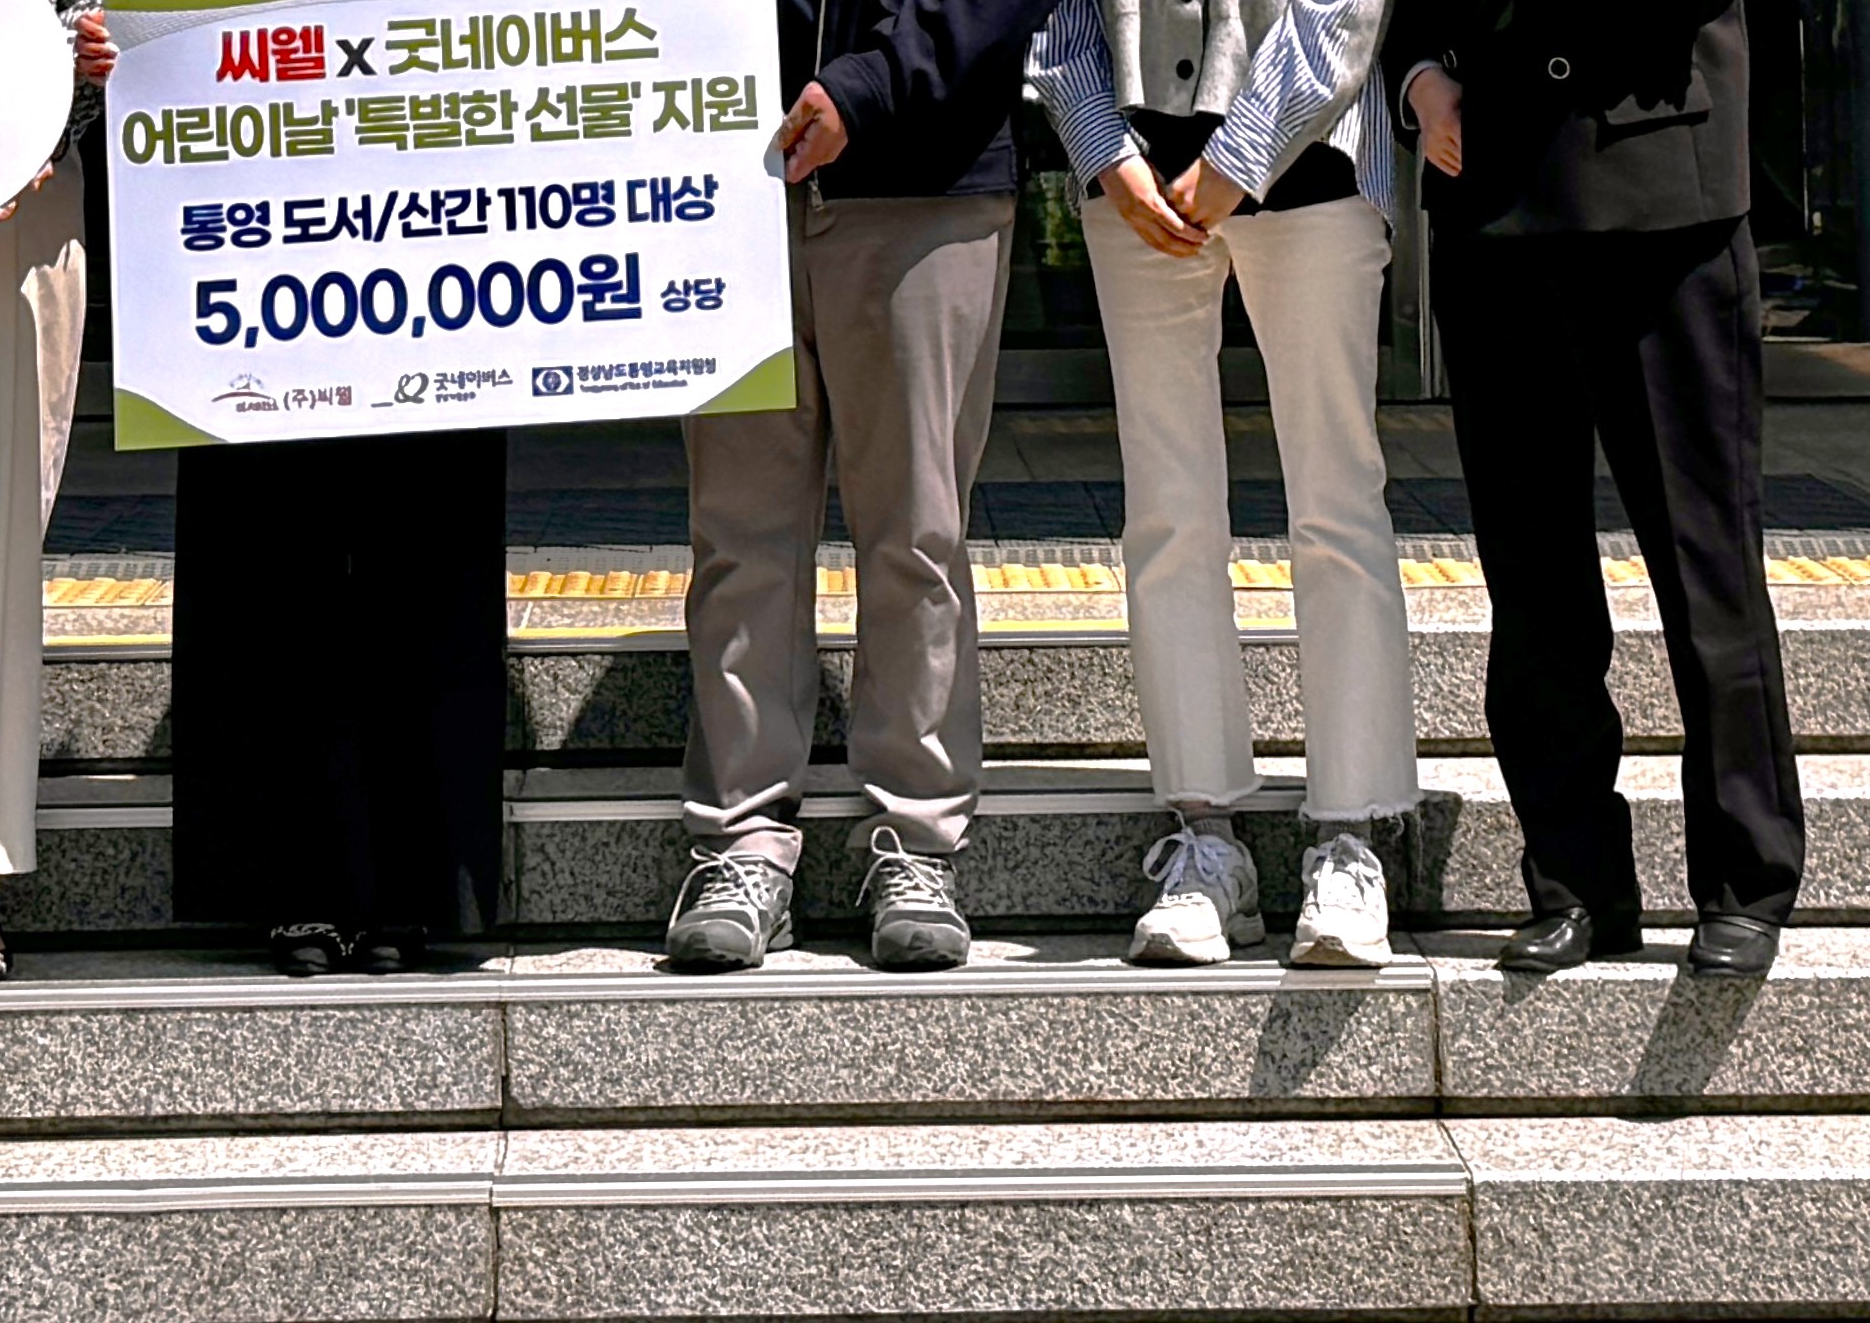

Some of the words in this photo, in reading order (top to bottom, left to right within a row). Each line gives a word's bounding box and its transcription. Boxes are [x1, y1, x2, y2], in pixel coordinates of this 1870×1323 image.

[216, 26, 326, 83] 씨웰
[386, 8, 658, 75] 굿네이버스
[123, 100, 338, 164] 어린이날
[346, 90, 518, 150] '특별한
[526, 82, 640, 141] 선물'
[653, 76, 758, 132] 지원
[181, 201, 271, 251] 통영
[283, 188, 491, 244] 도서/산간
[497, 180, 616, 231] 110명
[627, 174, 718, 222] 대상
[196, 253, 642, 348] 5,000,000원
[661, 278, 725, 312] 상당
[434, 368, 514, 392] 굿네이버스
